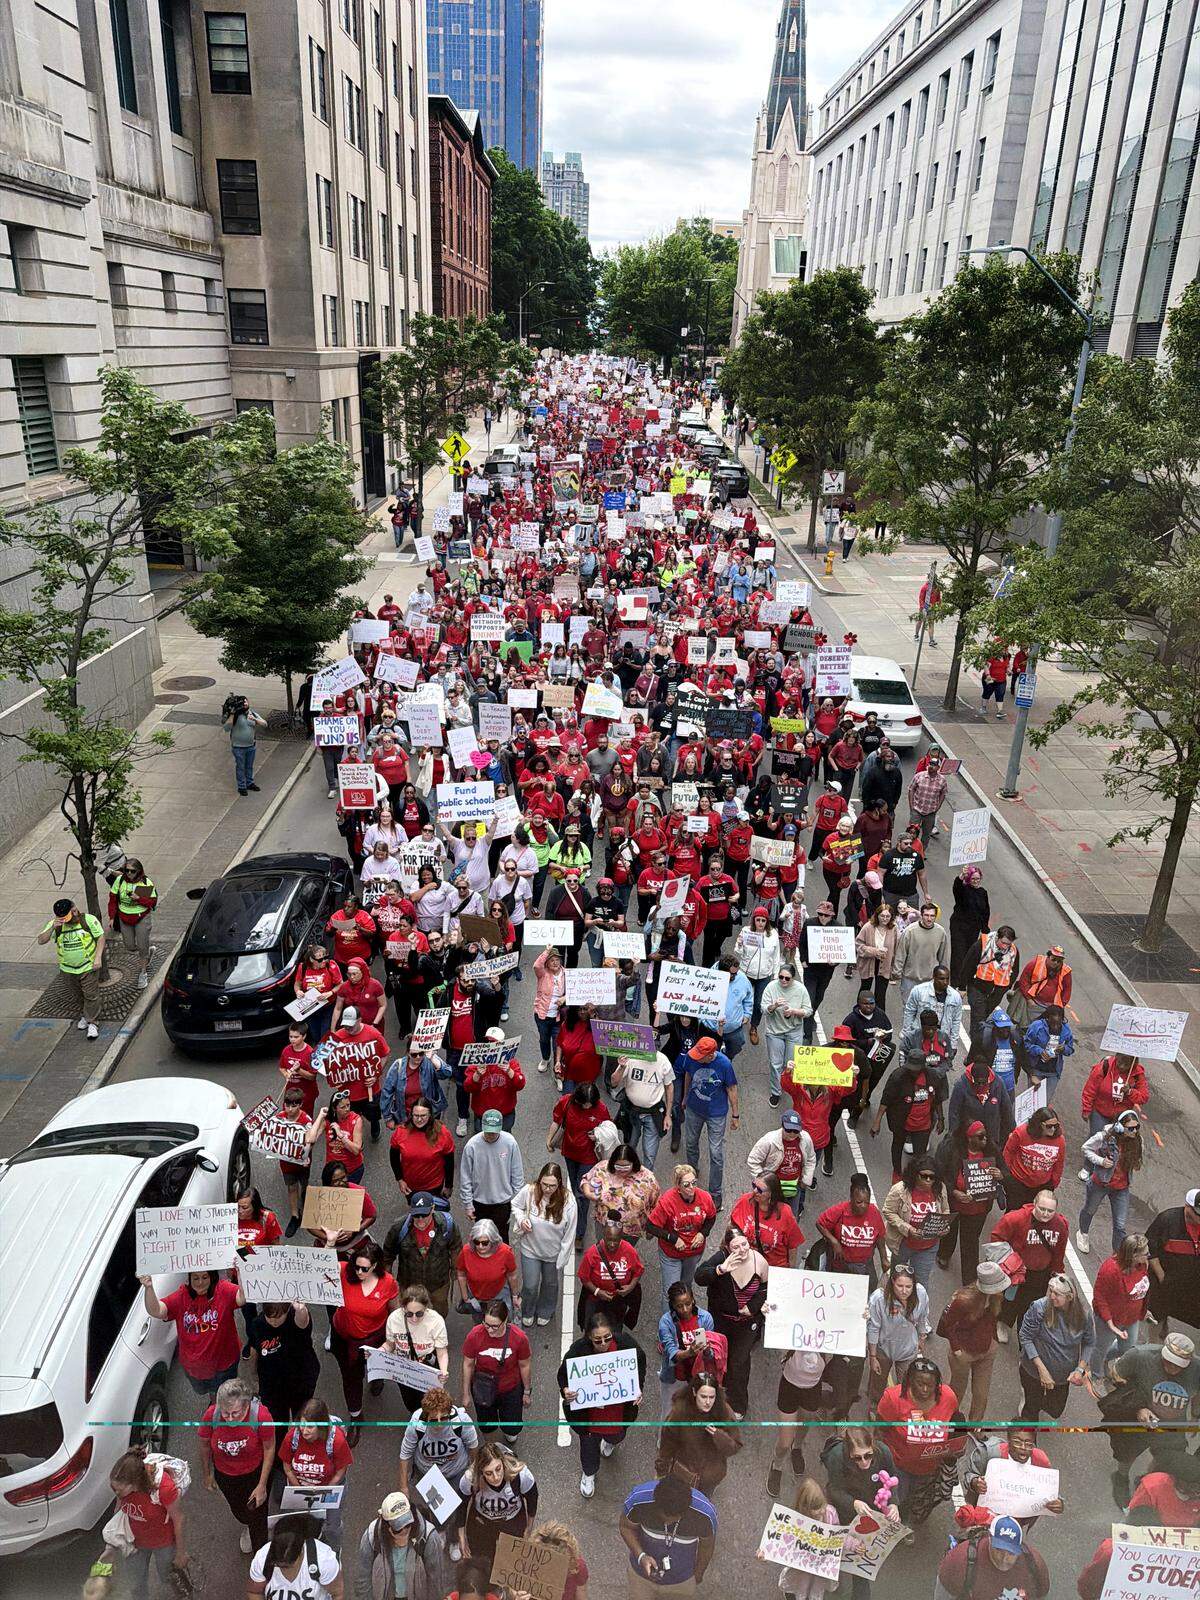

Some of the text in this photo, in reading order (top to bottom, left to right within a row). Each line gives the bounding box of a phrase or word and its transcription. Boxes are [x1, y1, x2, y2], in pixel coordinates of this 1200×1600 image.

[678, 700, 702, 711] believe
[315, 716, 358, 725] SHAME ON
[316, 732, 360, 745] FUND US
[454, 786, 477, 795] Fund
[777, 786, 803, 797] KIDS
[437, 795, 495, 809] public schools
[456, 808, 495, 818] vouchers
[403, 855, 440, 866] FOR THEM
[823, 936, 840, 944] FUND
[820, 944, 844, 952] PUBLIC
[818, 952, 847, 960] SCHOOLS
[465, 966, 486, 976] GOOD
[578, 970, 607, 980] support
[669, 965, 690, 977] North
[665, 976, 686, 986] FIRST
[696, 980, 717, 993] Flight
[419, 1008, 451, 1019] TEACHERS
[698, 1006, 721, 1020] Future!
[416, 1026, 444, 1035] ACCEPT
[596, 1023, 623, 1032] LOVE NC
[1128, 1018, 1167, 1034] Kids
[418, 1042, 435, 1050] WORK
[618, 1039, 649, 1050] FUND NC
[328, 1049, 348, 1069] AM
[355, 1040, 378, 1062] NOT
[873, 1043, 892, 1064] KIDS
[328, 1055, 382, 1084] worth it?
[260, 1119, 277, 1135] AM
[286, 1127, 306, 1145] NOT
[256, 1133, 293, 1157] WORTH
[968, 1175, 993, 1183] FUNDED
[970, 1169, 990, 1177] FULLY
[317, 1190, 349, 1202] KIDS
[966, 1187, 997, 1196] SCHOOLS
[138, 1208, 201, 1224] I LOVE MY
[313, 1213, 344, 1226] WAIT
[140, 1228, 158, 1239] WAY
[167, 1226, 182, 1236] TOO
[185, 1225, 209, 1235] MUCH
[213, 1223, 227, 1234] NOT
[841, 1224, 874, 1239] NCAE
[143, 1240, 177, 1254] FIGHT
[185, 1239, 200, 1250] FOR
[205, 1237, 235, 1248] THEIR
[170, 1252, 213, 1271] FUTURE
[267, 1247, 332, 1263] Time to use
[273, 1261, 312, 1273] OUTSIDE
[246, 1279, 312, 1300] MY VOICE
[801, 1277, 845, 1299] Pass
[201, 1309, 219, 1323] the
[815, 1306, 826, 1322] a
[569, 1356, 637, 1380] Advocating
[594, 1368, 619, 1386] IS
[575, 1387, 600, 1405] Our
[1152, 1390, 1190, 1410] VOTE
[421, 1438, 458, 1457] KIDS
[999, 1480, 1036, 1496] DESERVE
[480, 1495, 519, 1512] KIDS
[774, 1512, 825, 1536] WE OUR
[767, 1530, 782, 1541] WE
[511, 1539, 552, 1566] FUND
[795, 1540, 818, 1554] PUBLIC
[857, 1548, 880, 1577] NC
[1118, 1546, 1181, 1568] YOU CAN'T
[513, 1559, 540, 1580] OUR
[497, 1569, 554, 1600] SCHOOLS
